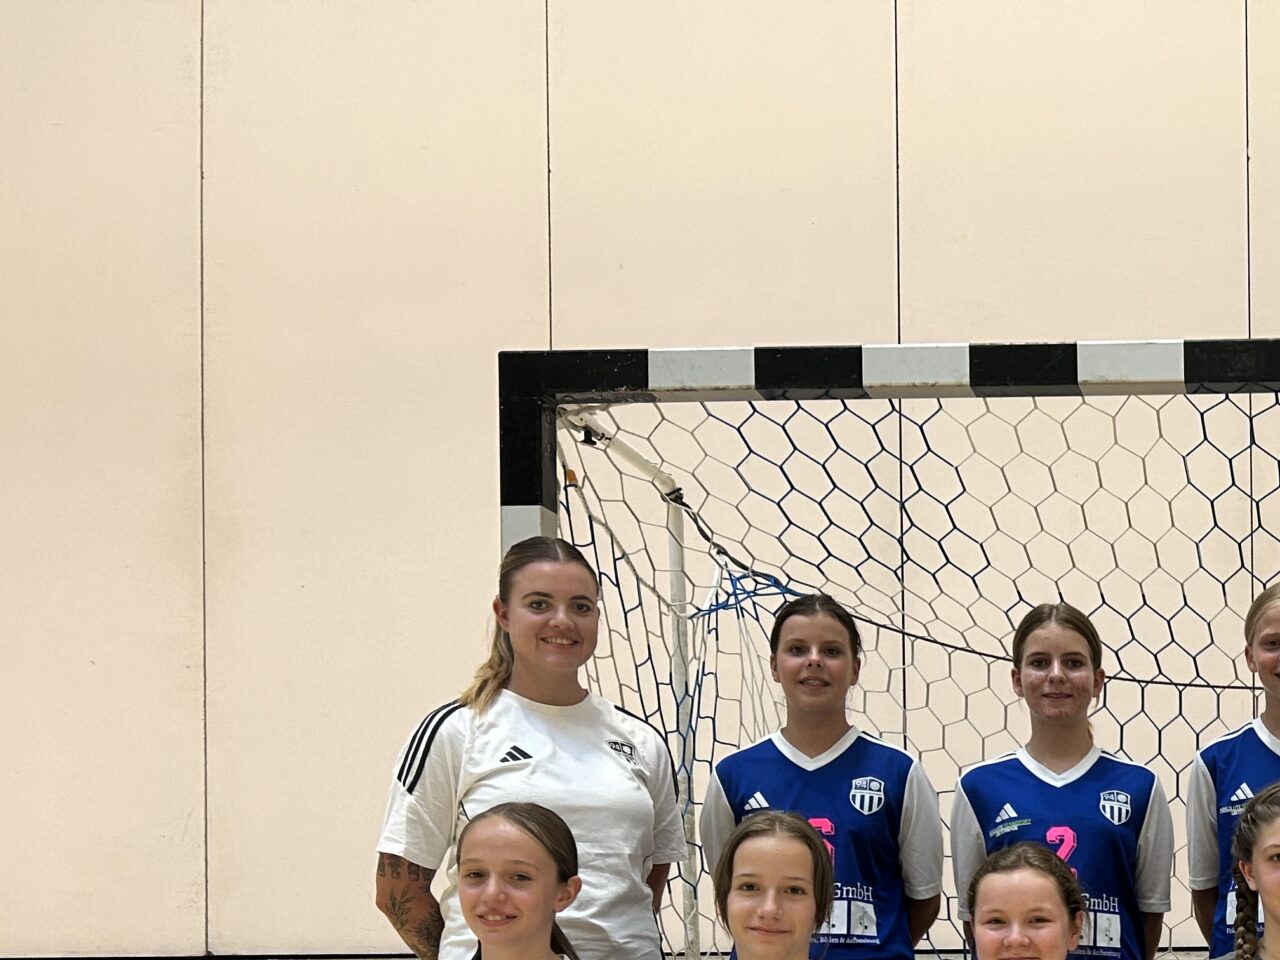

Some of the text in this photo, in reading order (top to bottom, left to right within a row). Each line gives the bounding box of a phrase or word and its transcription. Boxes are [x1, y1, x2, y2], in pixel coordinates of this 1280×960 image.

[855, 781, 868, 789] 94
[1103, 793, 1115, 801] 94
[1046, 826, 1078, 880] 2
[833, 882, 874, 901] GmbH
